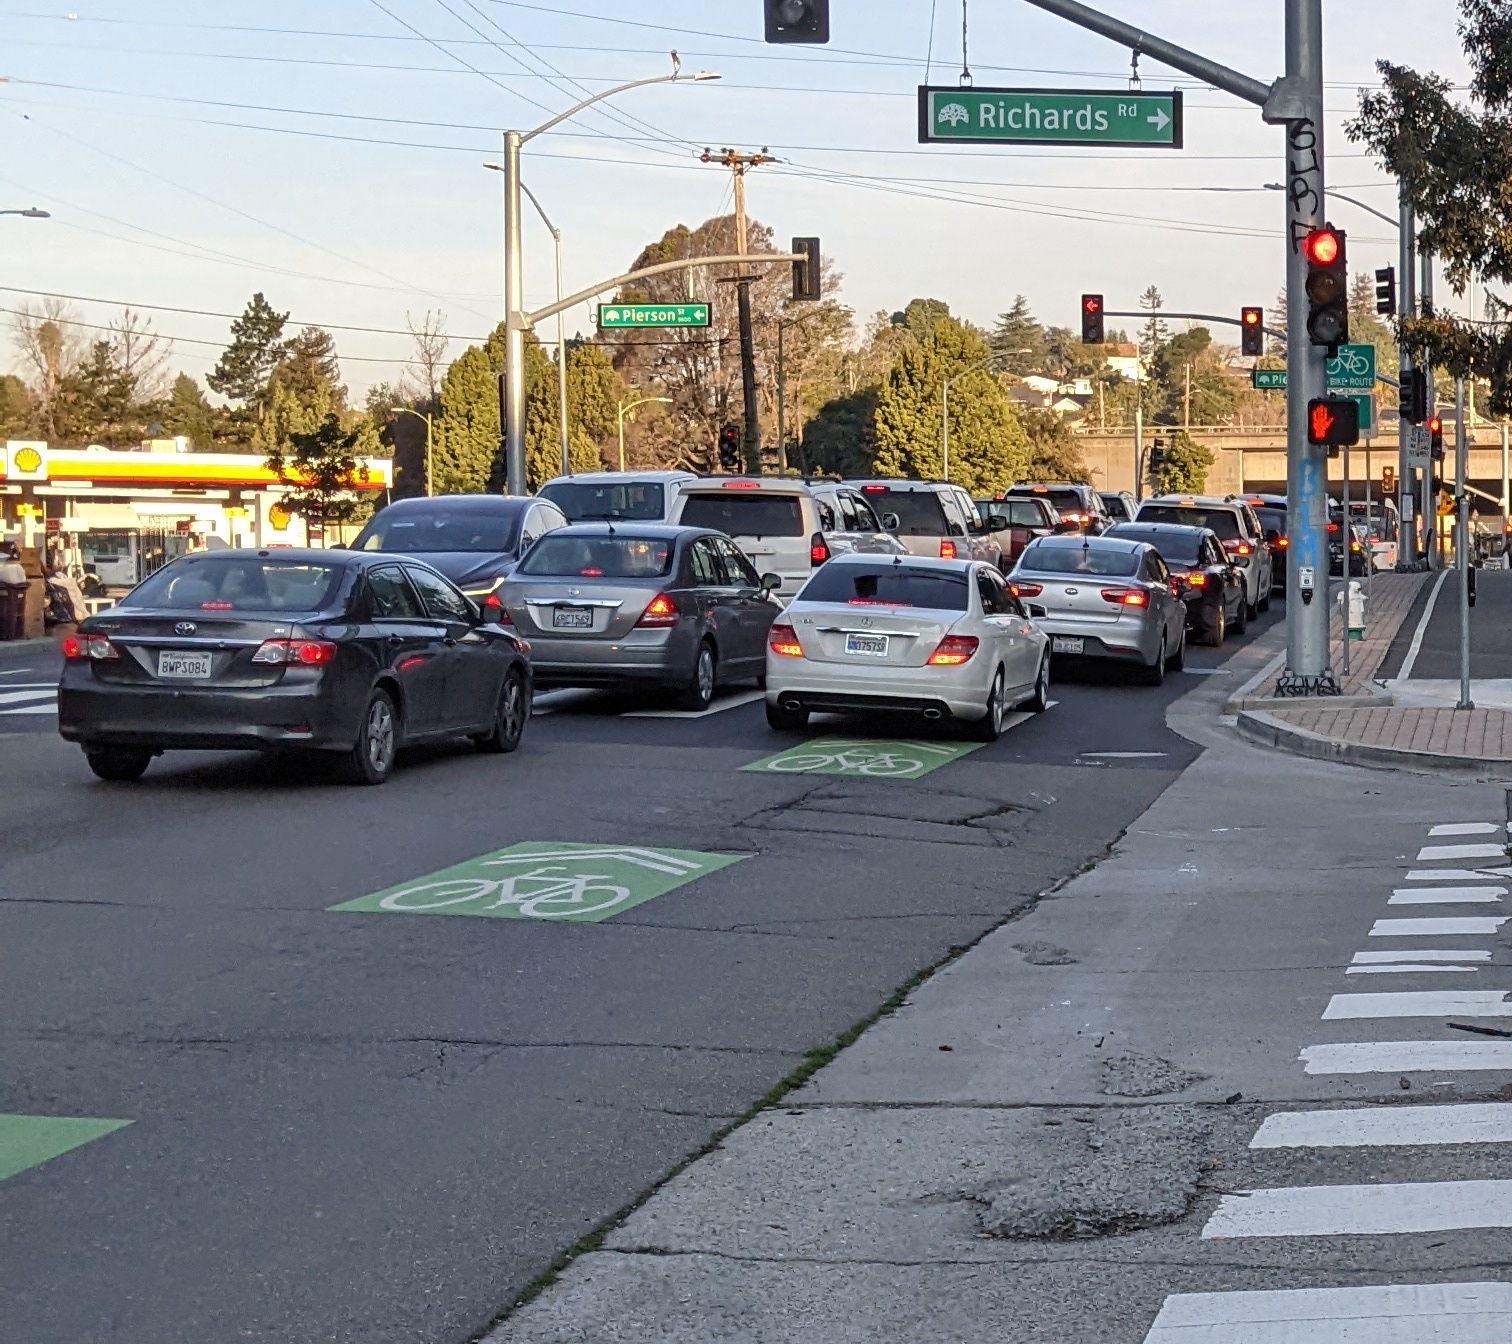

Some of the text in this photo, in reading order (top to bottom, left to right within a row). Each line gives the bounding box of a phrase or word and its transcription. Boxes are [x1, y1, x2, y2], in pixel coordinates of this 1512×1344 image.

[979, 100, 1138, 131] Richards Rd
[622, 309, 676, 322] Pierson
[1350, 377, 1373, 387] ROUTE
